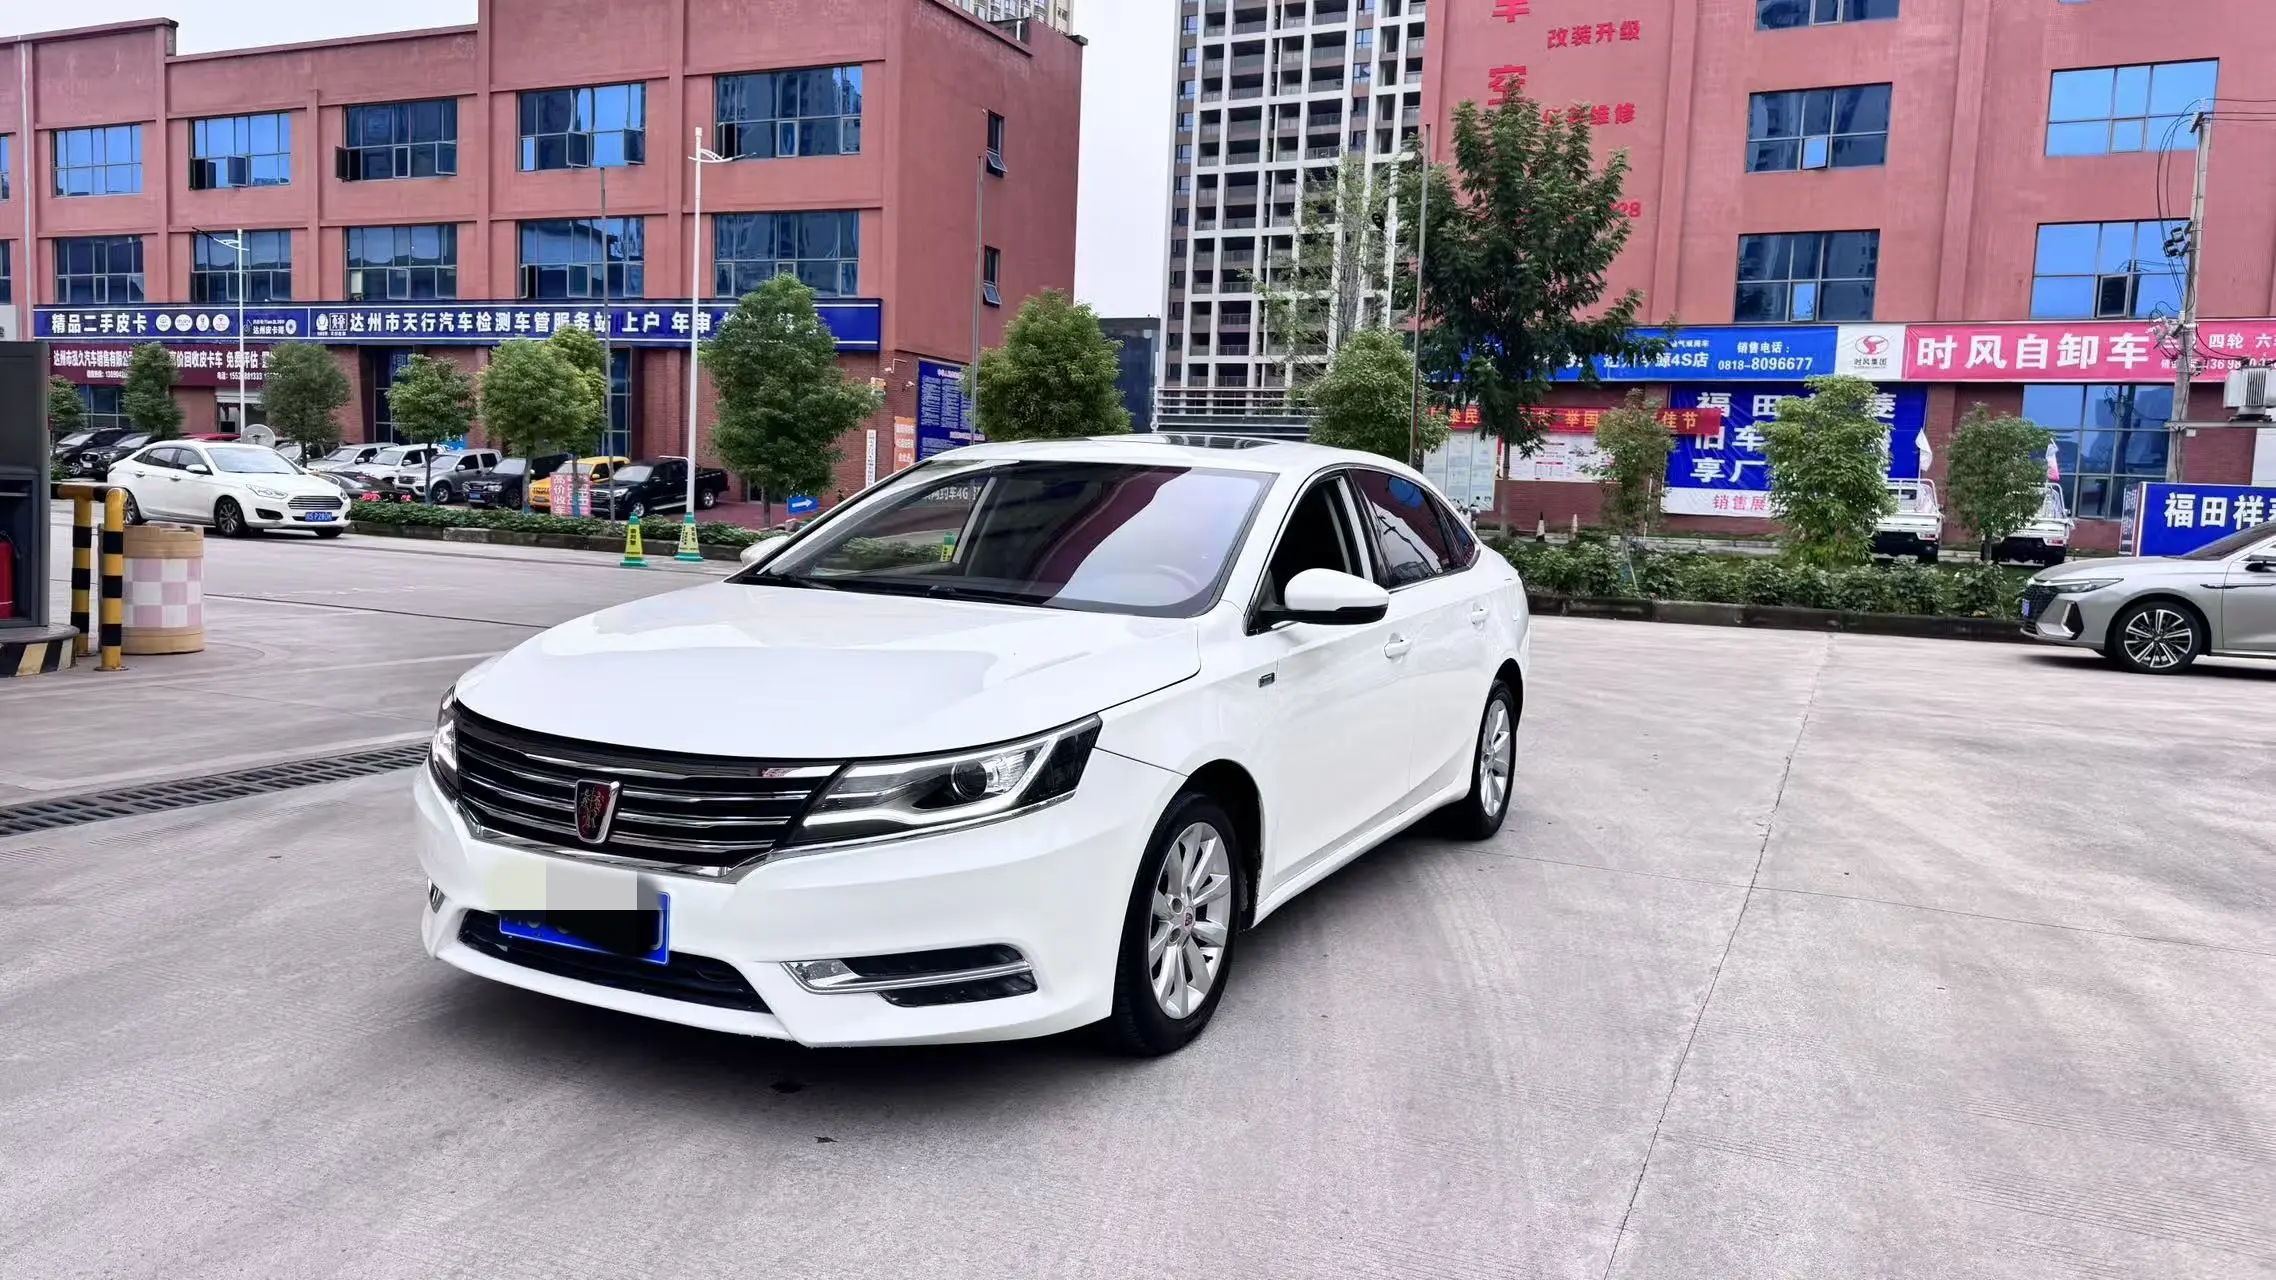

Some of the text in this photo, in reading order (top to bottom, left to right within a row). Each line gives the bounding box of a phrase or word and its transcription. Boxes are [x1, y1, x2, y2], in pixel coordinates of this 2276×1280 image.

[1547, 20, 1641, 49] 改装升级
[51, 312, 148, 334] 精品二手皮卡
[349, 311, 612, 333] 达州市天行汽车检测车管服务站
[622, 311, 660, 333] 上户
[1916, 332, 2150, 370] 时风自卸车
[2208, 333, 2243, 349] 四轮
[1717, 356, 1813, 371] 0818-8096677
